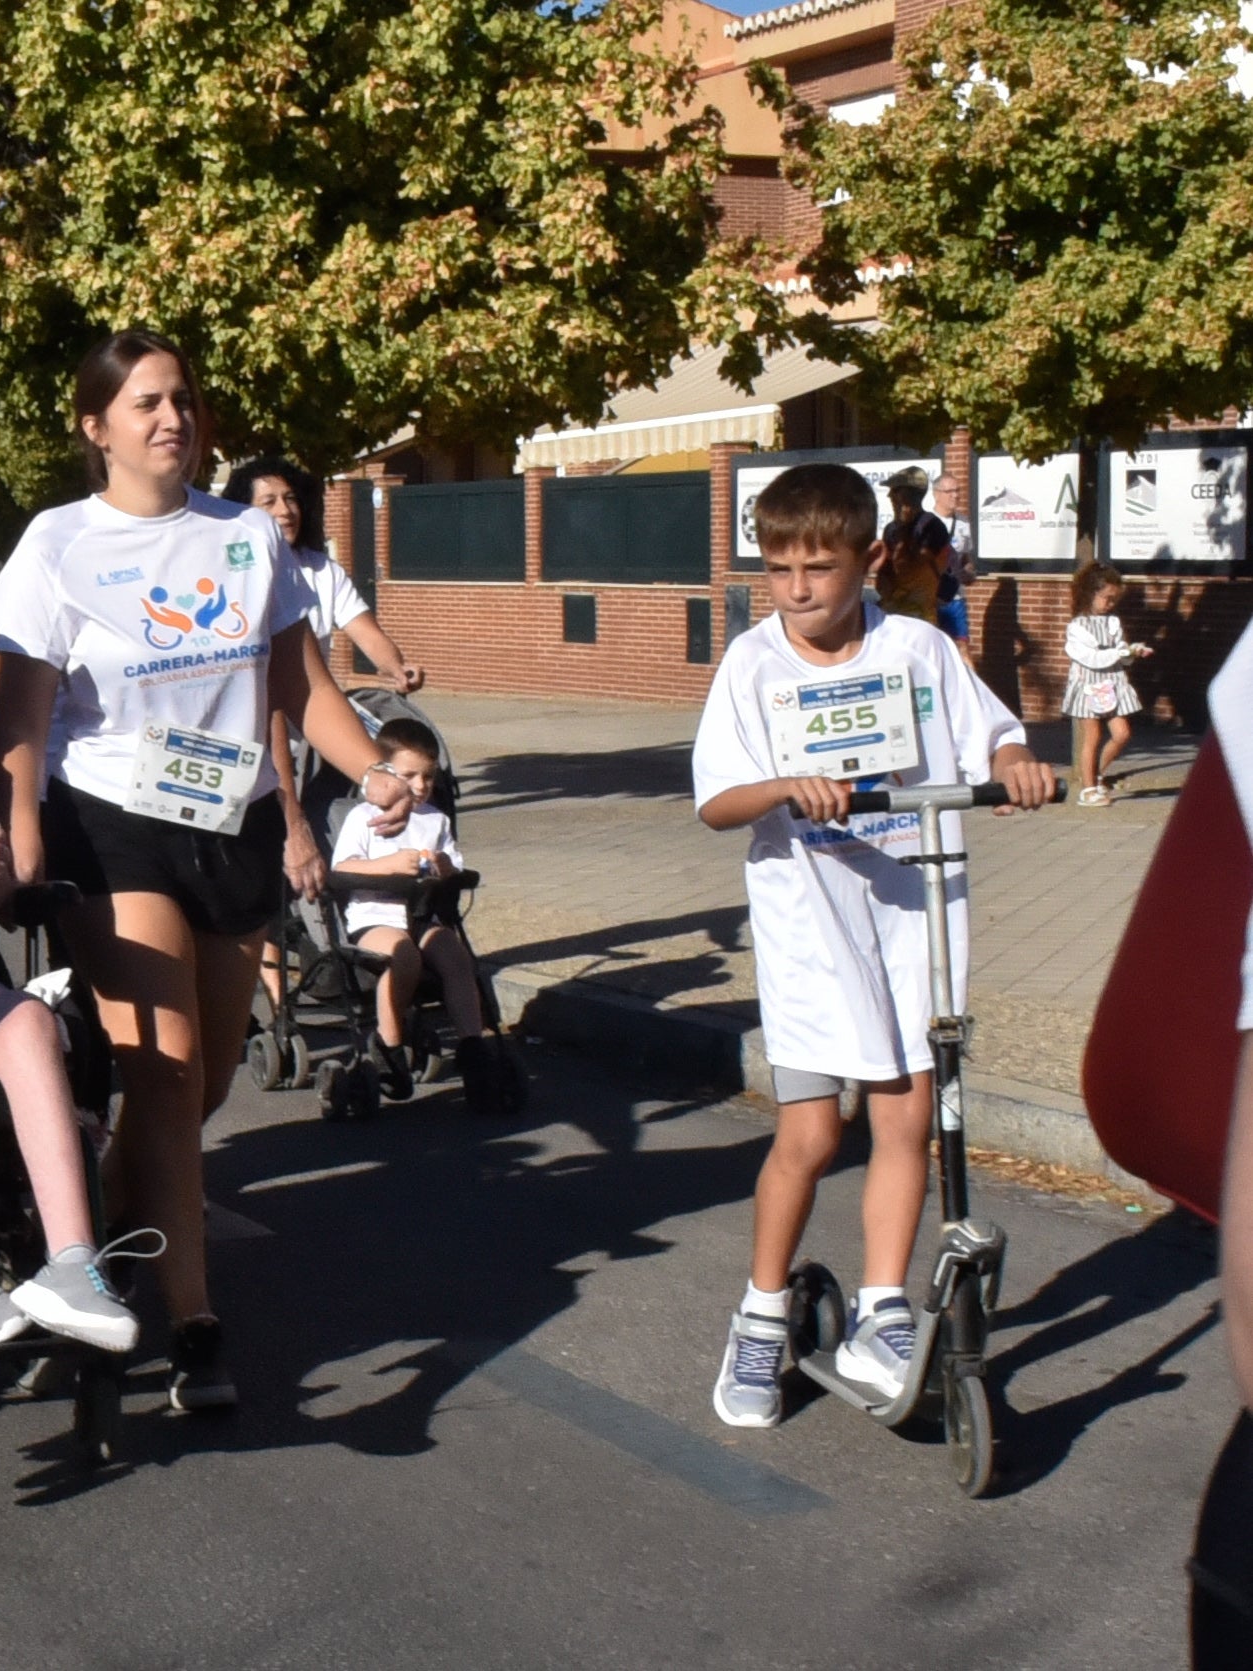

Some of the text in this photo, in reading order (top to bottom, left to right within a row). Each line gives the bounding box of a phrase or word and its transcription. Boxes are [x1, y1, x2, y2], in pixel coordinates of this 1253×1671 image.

[123, 642, 270, 678] CARRERA-MARCH
[805, 704, 878, 737] 455
[164, 758, 224, 789] 453
